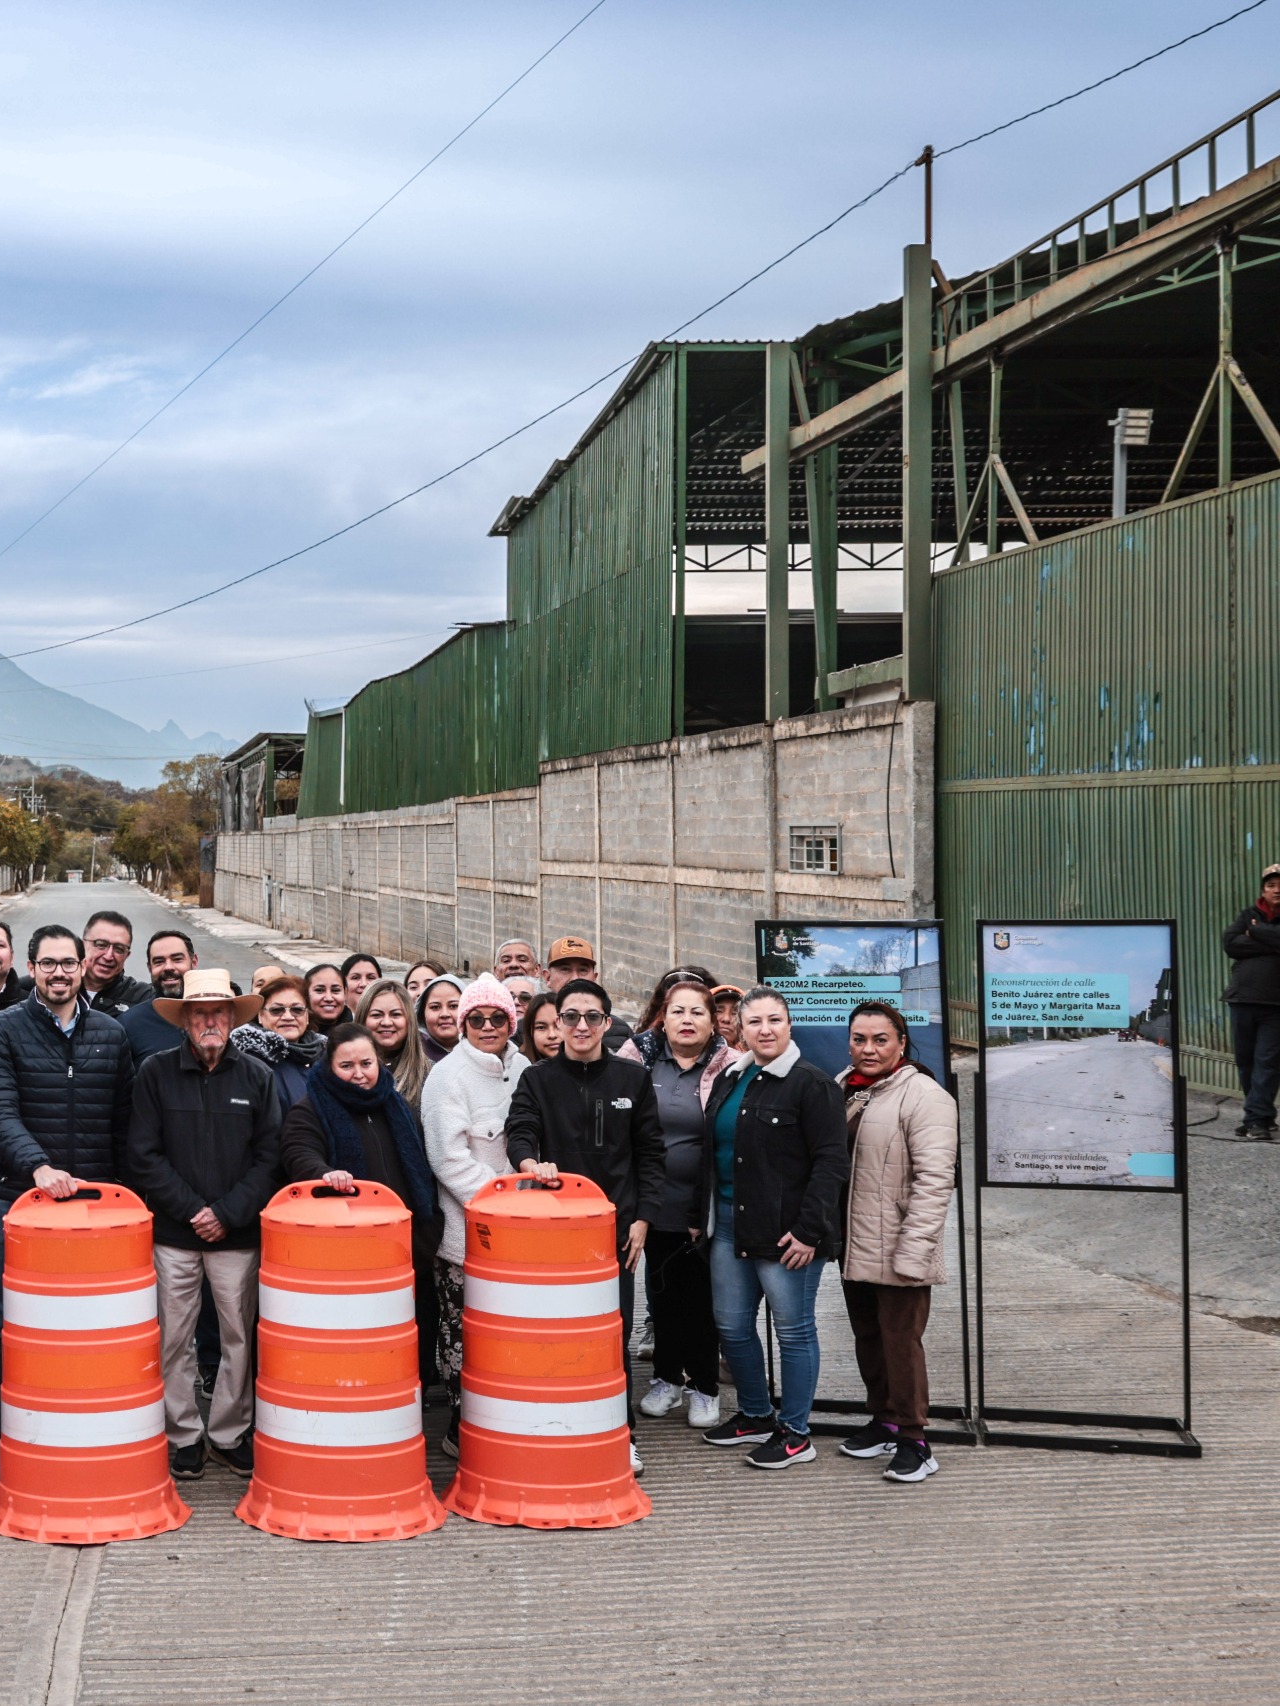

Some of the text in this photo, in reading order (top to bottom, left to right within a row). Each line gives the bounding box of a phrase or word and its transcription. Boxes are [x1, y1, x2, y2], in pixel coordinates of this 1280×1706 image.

[773, 980, 866, 990] 2420M2 Recarpeteo.
[991, 977, 1096, 987] Reconstrucción de calle
[991, 990, 1021, 998] Benito
[1023, 990, 1053, 998] Juárez
[1082, 991, 1110, 999] calles
[806, 997, 848, 1005] Concreto
[1014, 1002, 1038, 1010] Mayo
[1049, 1002, 1094, 1011] Margarita
[1006, 1013, 1039, 1022] Juárez,
[1061, 1013, 1084, 1021] José
[1031, 1152, 1062, 1162] mejores
[1014, 1162, 1052, 1170] Santiago,
